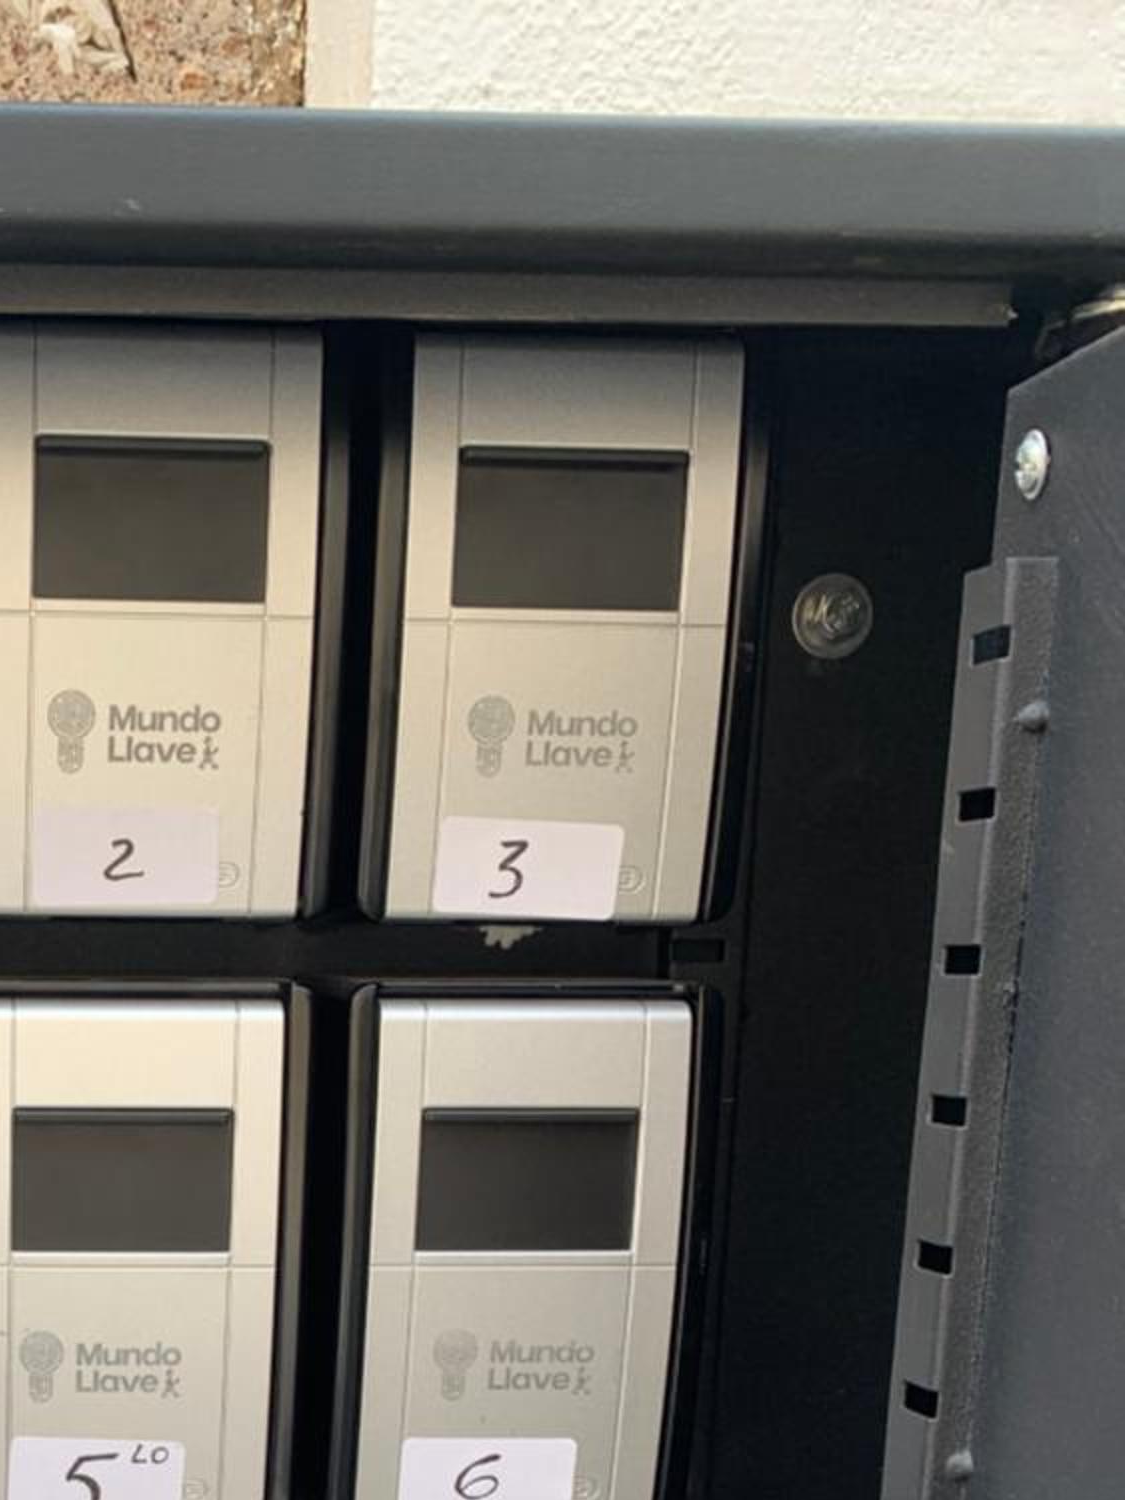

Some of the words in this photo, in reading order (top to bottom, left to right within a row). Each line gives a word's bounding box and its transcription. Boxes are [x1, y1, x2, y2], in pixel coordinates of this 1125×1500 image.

[107, 704, 222, 732] Mundo
[526, 710, 638, 738] Mundo
[106, 736, 198, 763] Llave
[525, 741, 612, 767] Llave
[102, 838, 145, 881] 2
[487, 839, 530, 899] 3
[75, 1341, 182, 1366] Mundo
[488, 1340, 595, 1363] Mundo
[75, 1370, 158, 1393] Llave
[487, 1367, 571, 1391] Llave
[453, 1453, 502, 1500] 6
